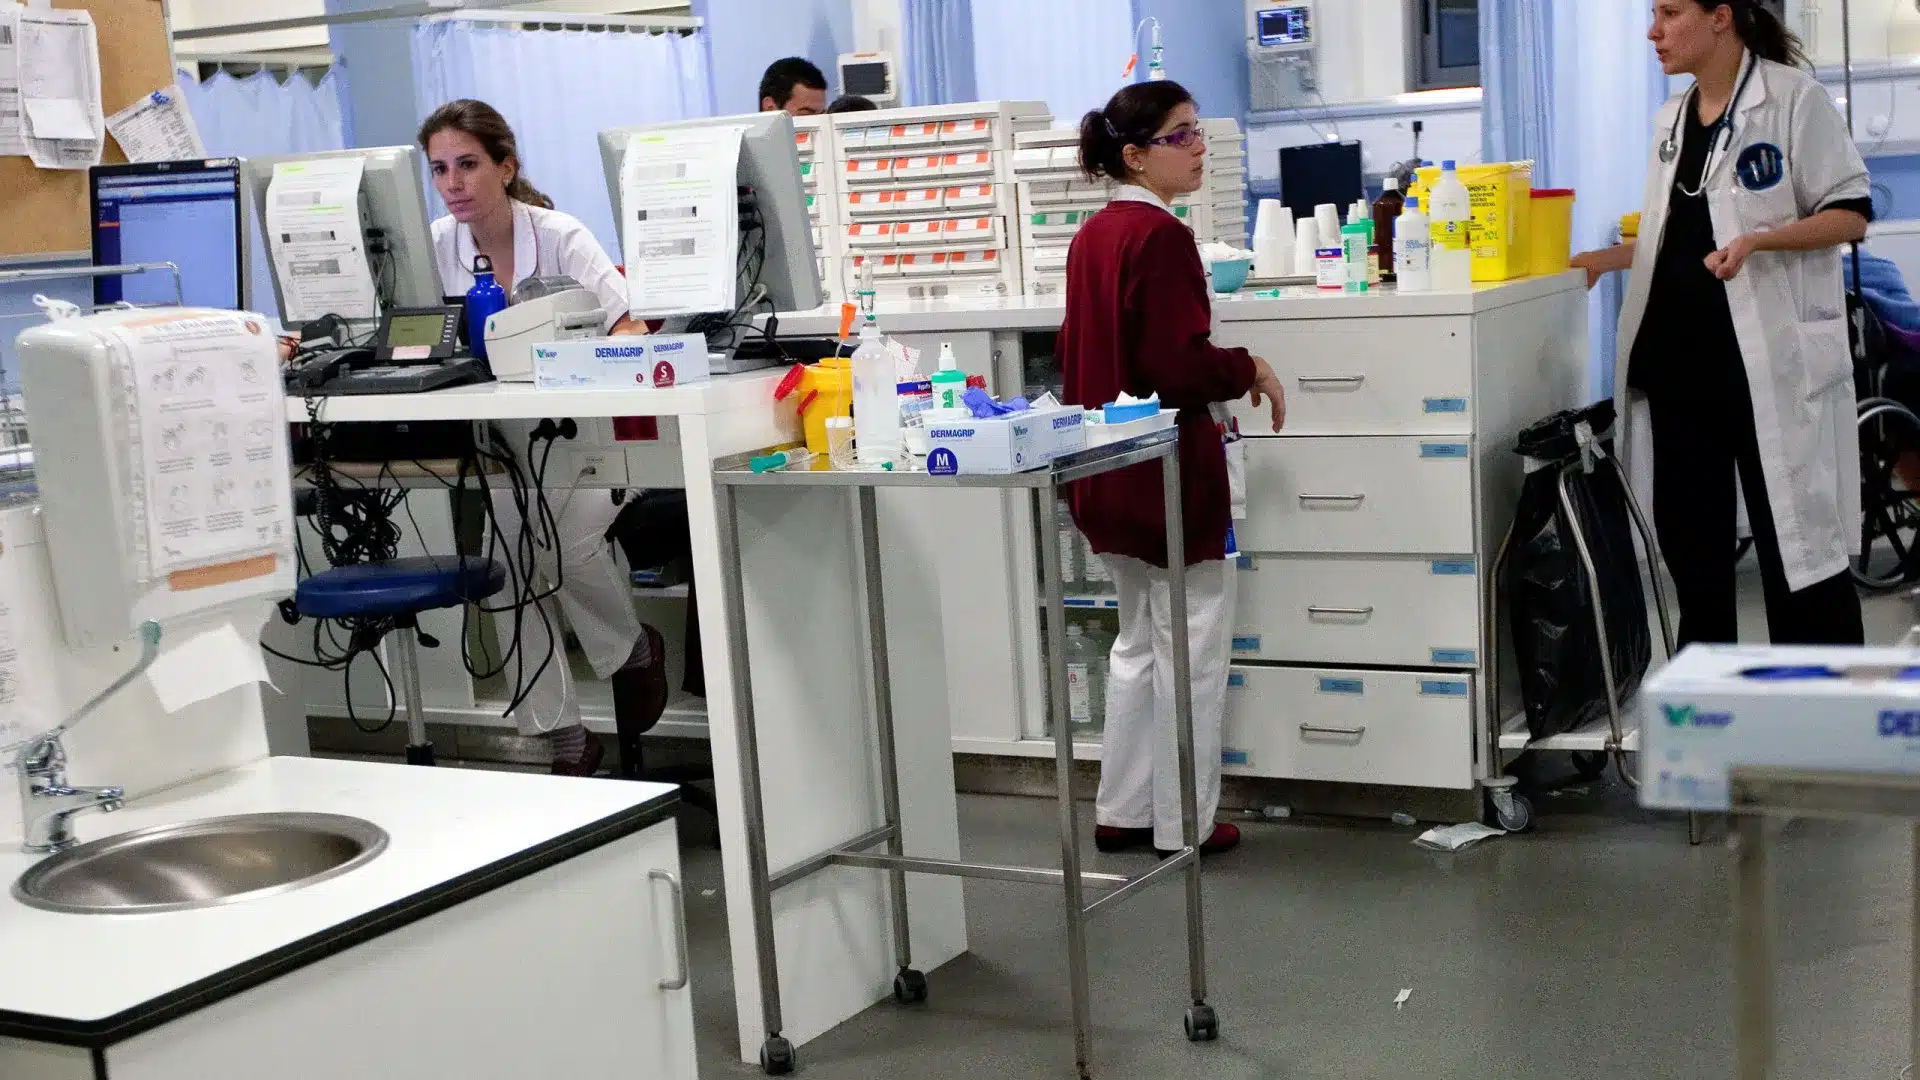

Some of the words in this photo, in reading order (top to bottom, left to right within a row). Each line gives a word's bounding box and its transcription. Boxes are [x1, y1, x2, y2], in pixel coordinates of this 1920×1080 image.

[595, 347, 644, 358] DERMAGRIP
[653, 342, 685, 353] DERMAGRIP
[661, 365, 668, 378] S
[1052, 413, 1083, 430] DERMAGRIP
[930, 428, 975, 439] DERMAGRIP
[936, 453, 949, 466] M
